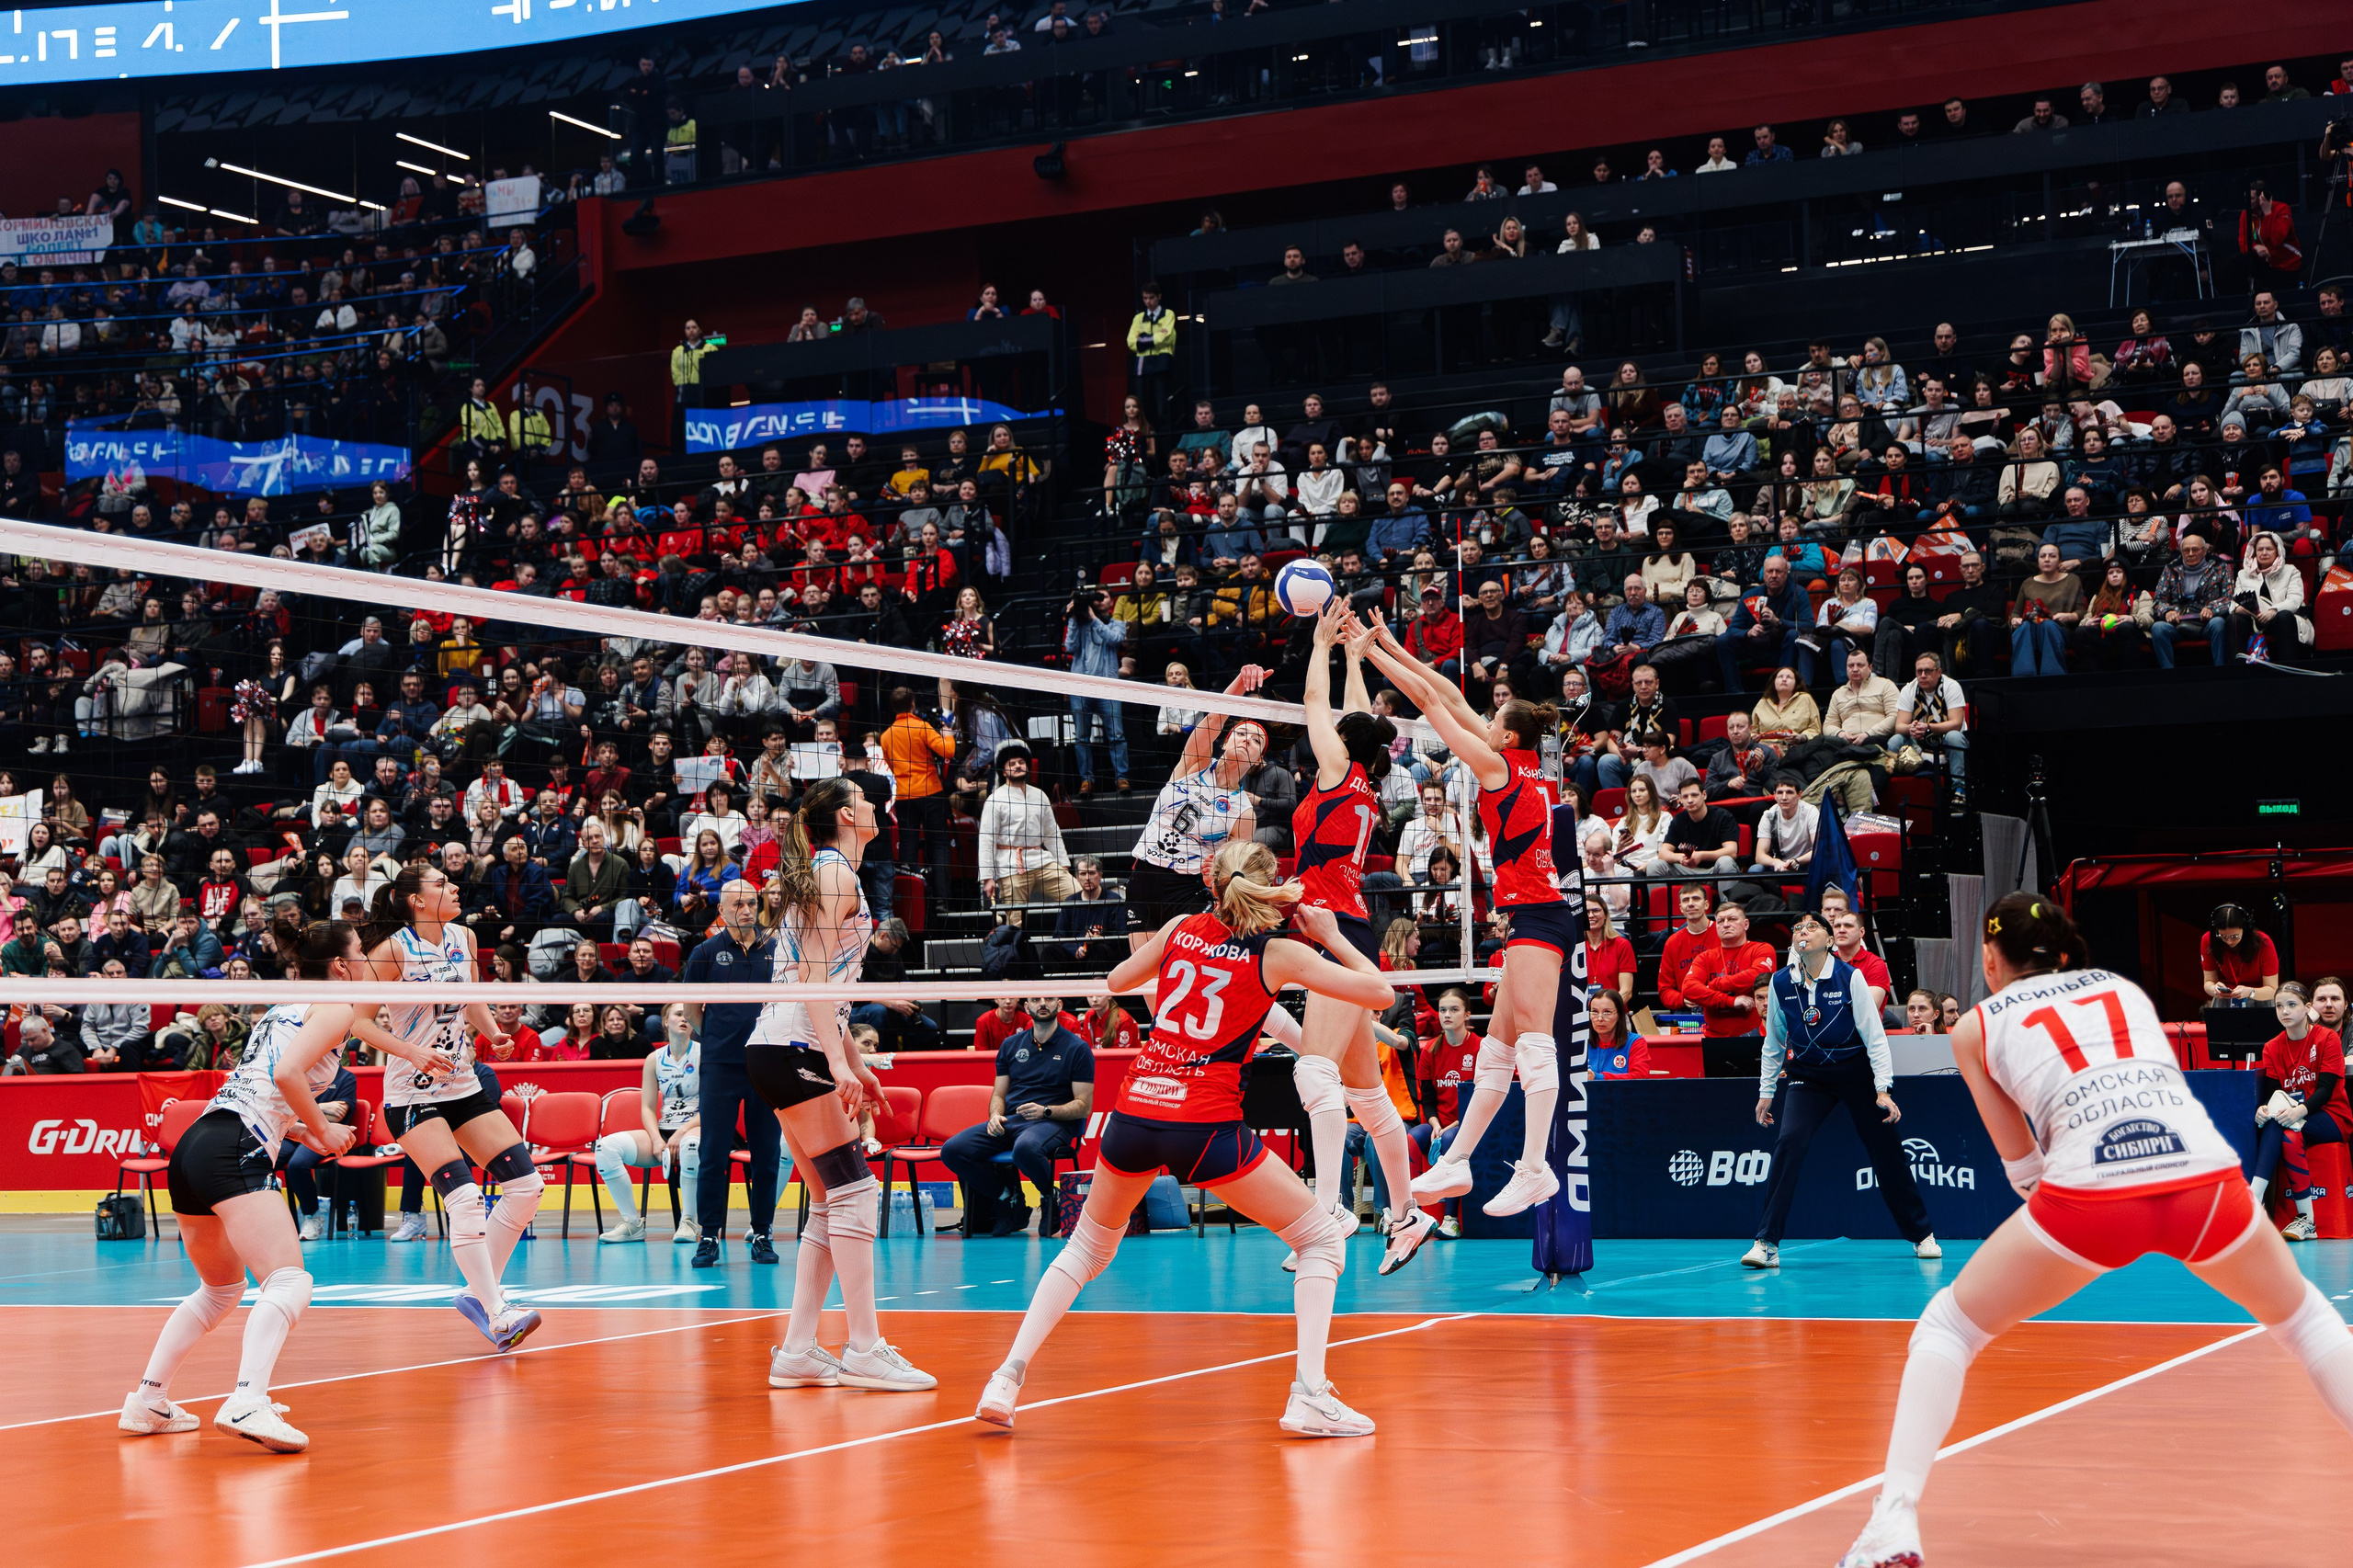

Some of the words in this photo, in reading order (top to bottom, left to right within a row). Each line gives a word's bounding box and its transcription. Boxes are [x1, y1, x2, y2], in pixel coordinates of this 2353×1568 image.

[1518, 766, 1545, 779] АЗНО
[2258, 804, 2298, 814] ВЫХОД
[1173, 930, 1251, 963] КОРЖОВА
[1155, 959, 1233, 1040] 23
[1988, 971, 2122, 1016] ВАСИЛЬЕВА
[2020, 990, 2134, 1074] 17
[1136, 1054, 1206, 1078] ОБЛАСТЬ
[1148, 1038, 1211, 1065] ОМСКАЯ
[2063, 1068, 2169, 1108] ОМСКАЯ
[2067, 1089, 2184, 1130] ОБЛАСТЬ
[2103, 1135, 2178, 1162] СИБИРИ
[1707, 1149, 1772, 1187] ВФ
